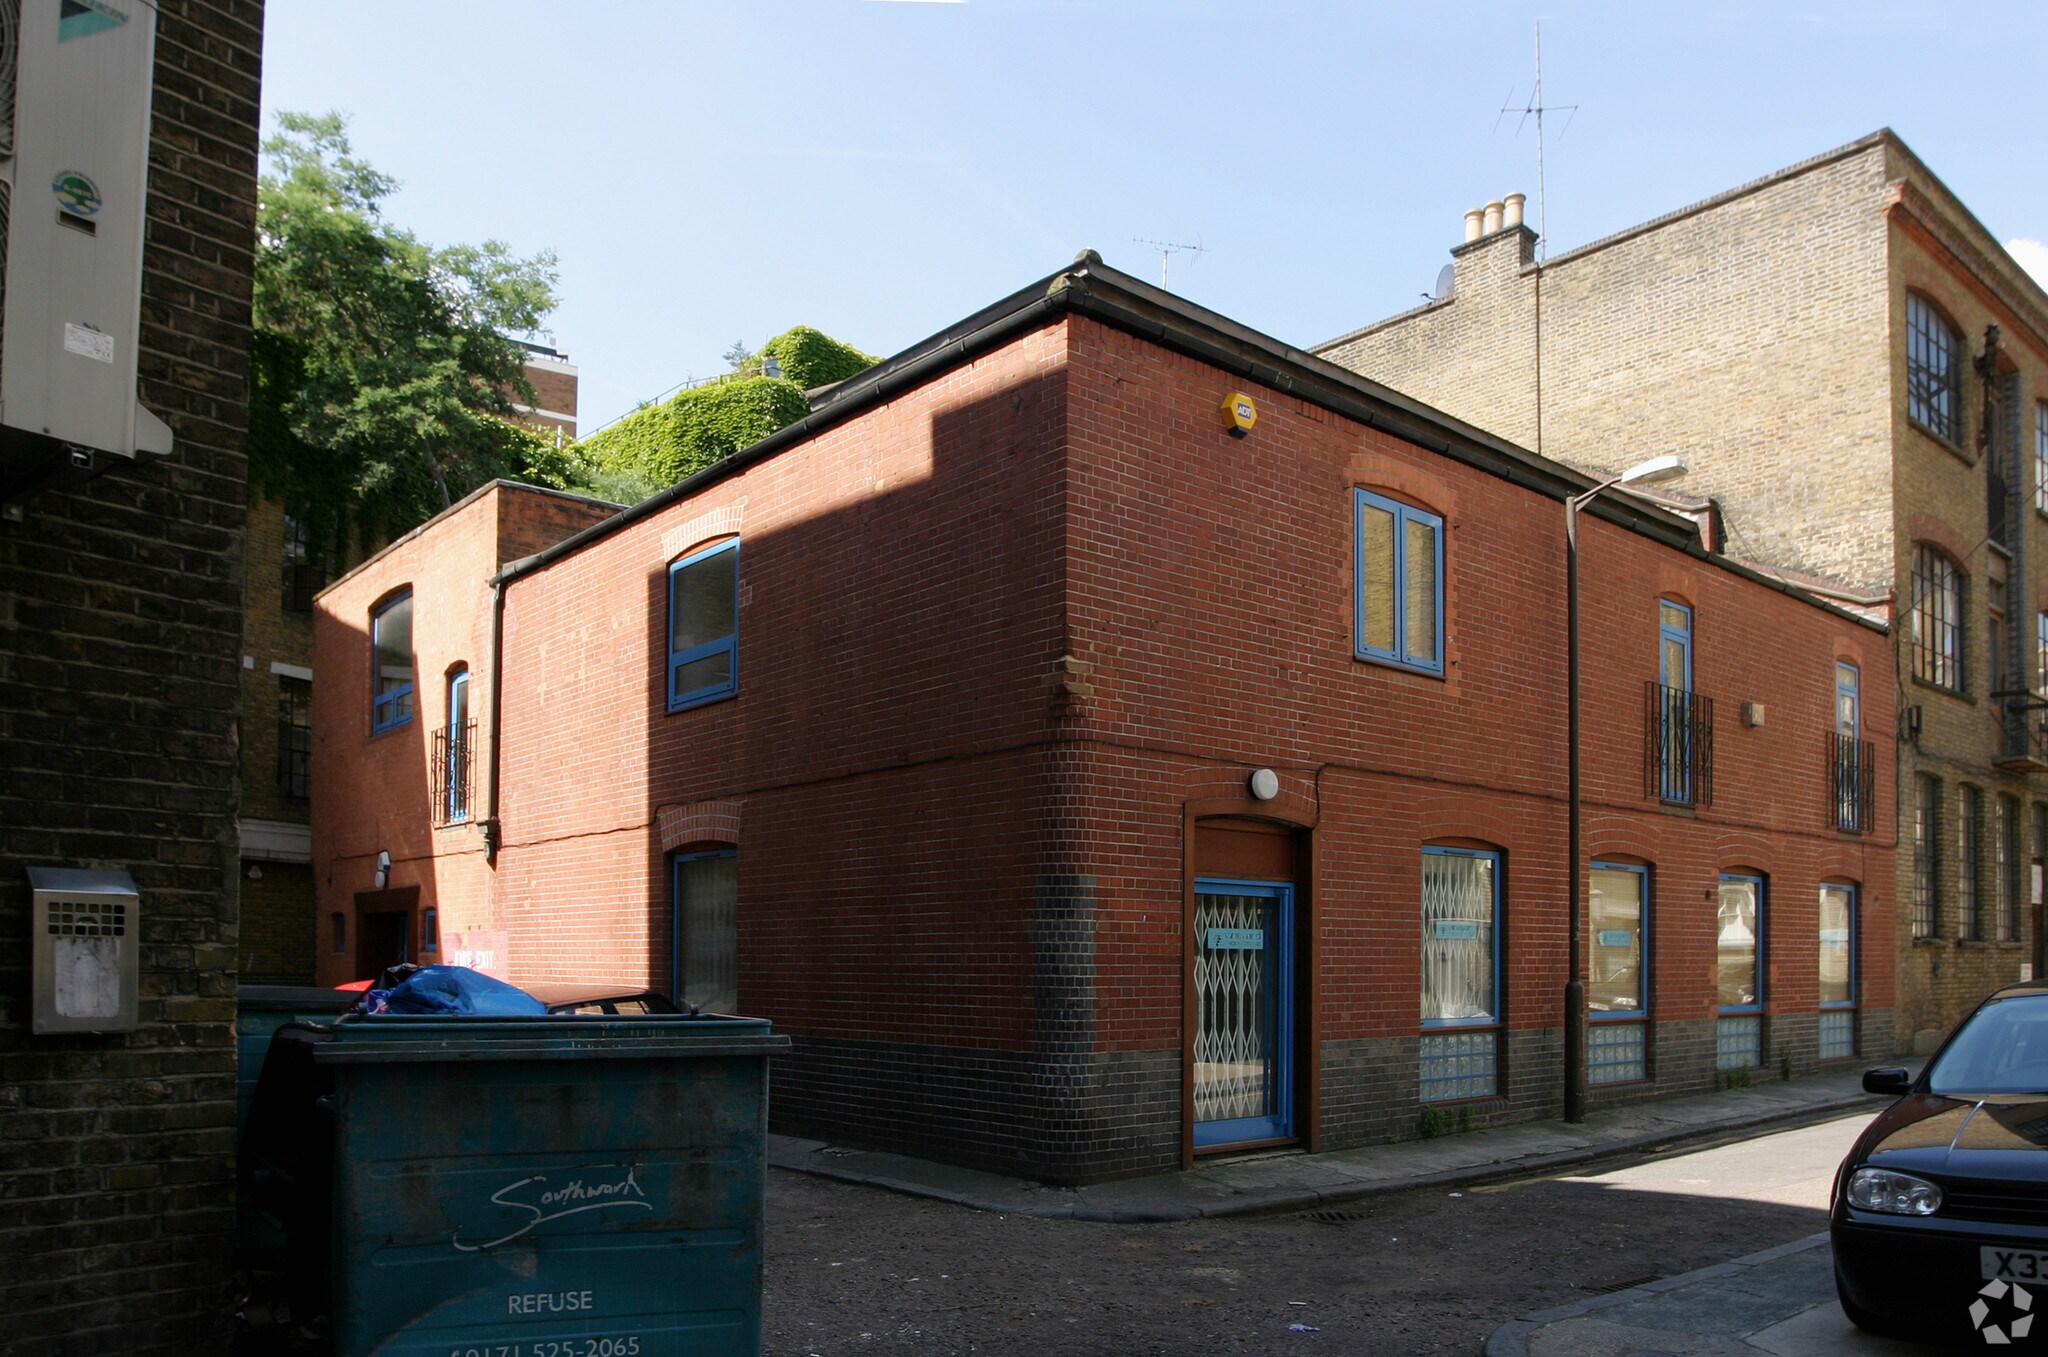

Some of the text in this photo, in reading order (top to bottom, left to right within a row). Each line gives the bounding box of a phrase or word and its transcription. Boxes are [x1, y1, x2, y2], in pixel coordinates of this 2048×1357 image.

[1237, 405, 1252, 418] ADT
[455, 950, 474, 967] FIRE
[508, 1292, 592, 1314] REFUSE
[533, 1336, 640, 1357] 525-2065
